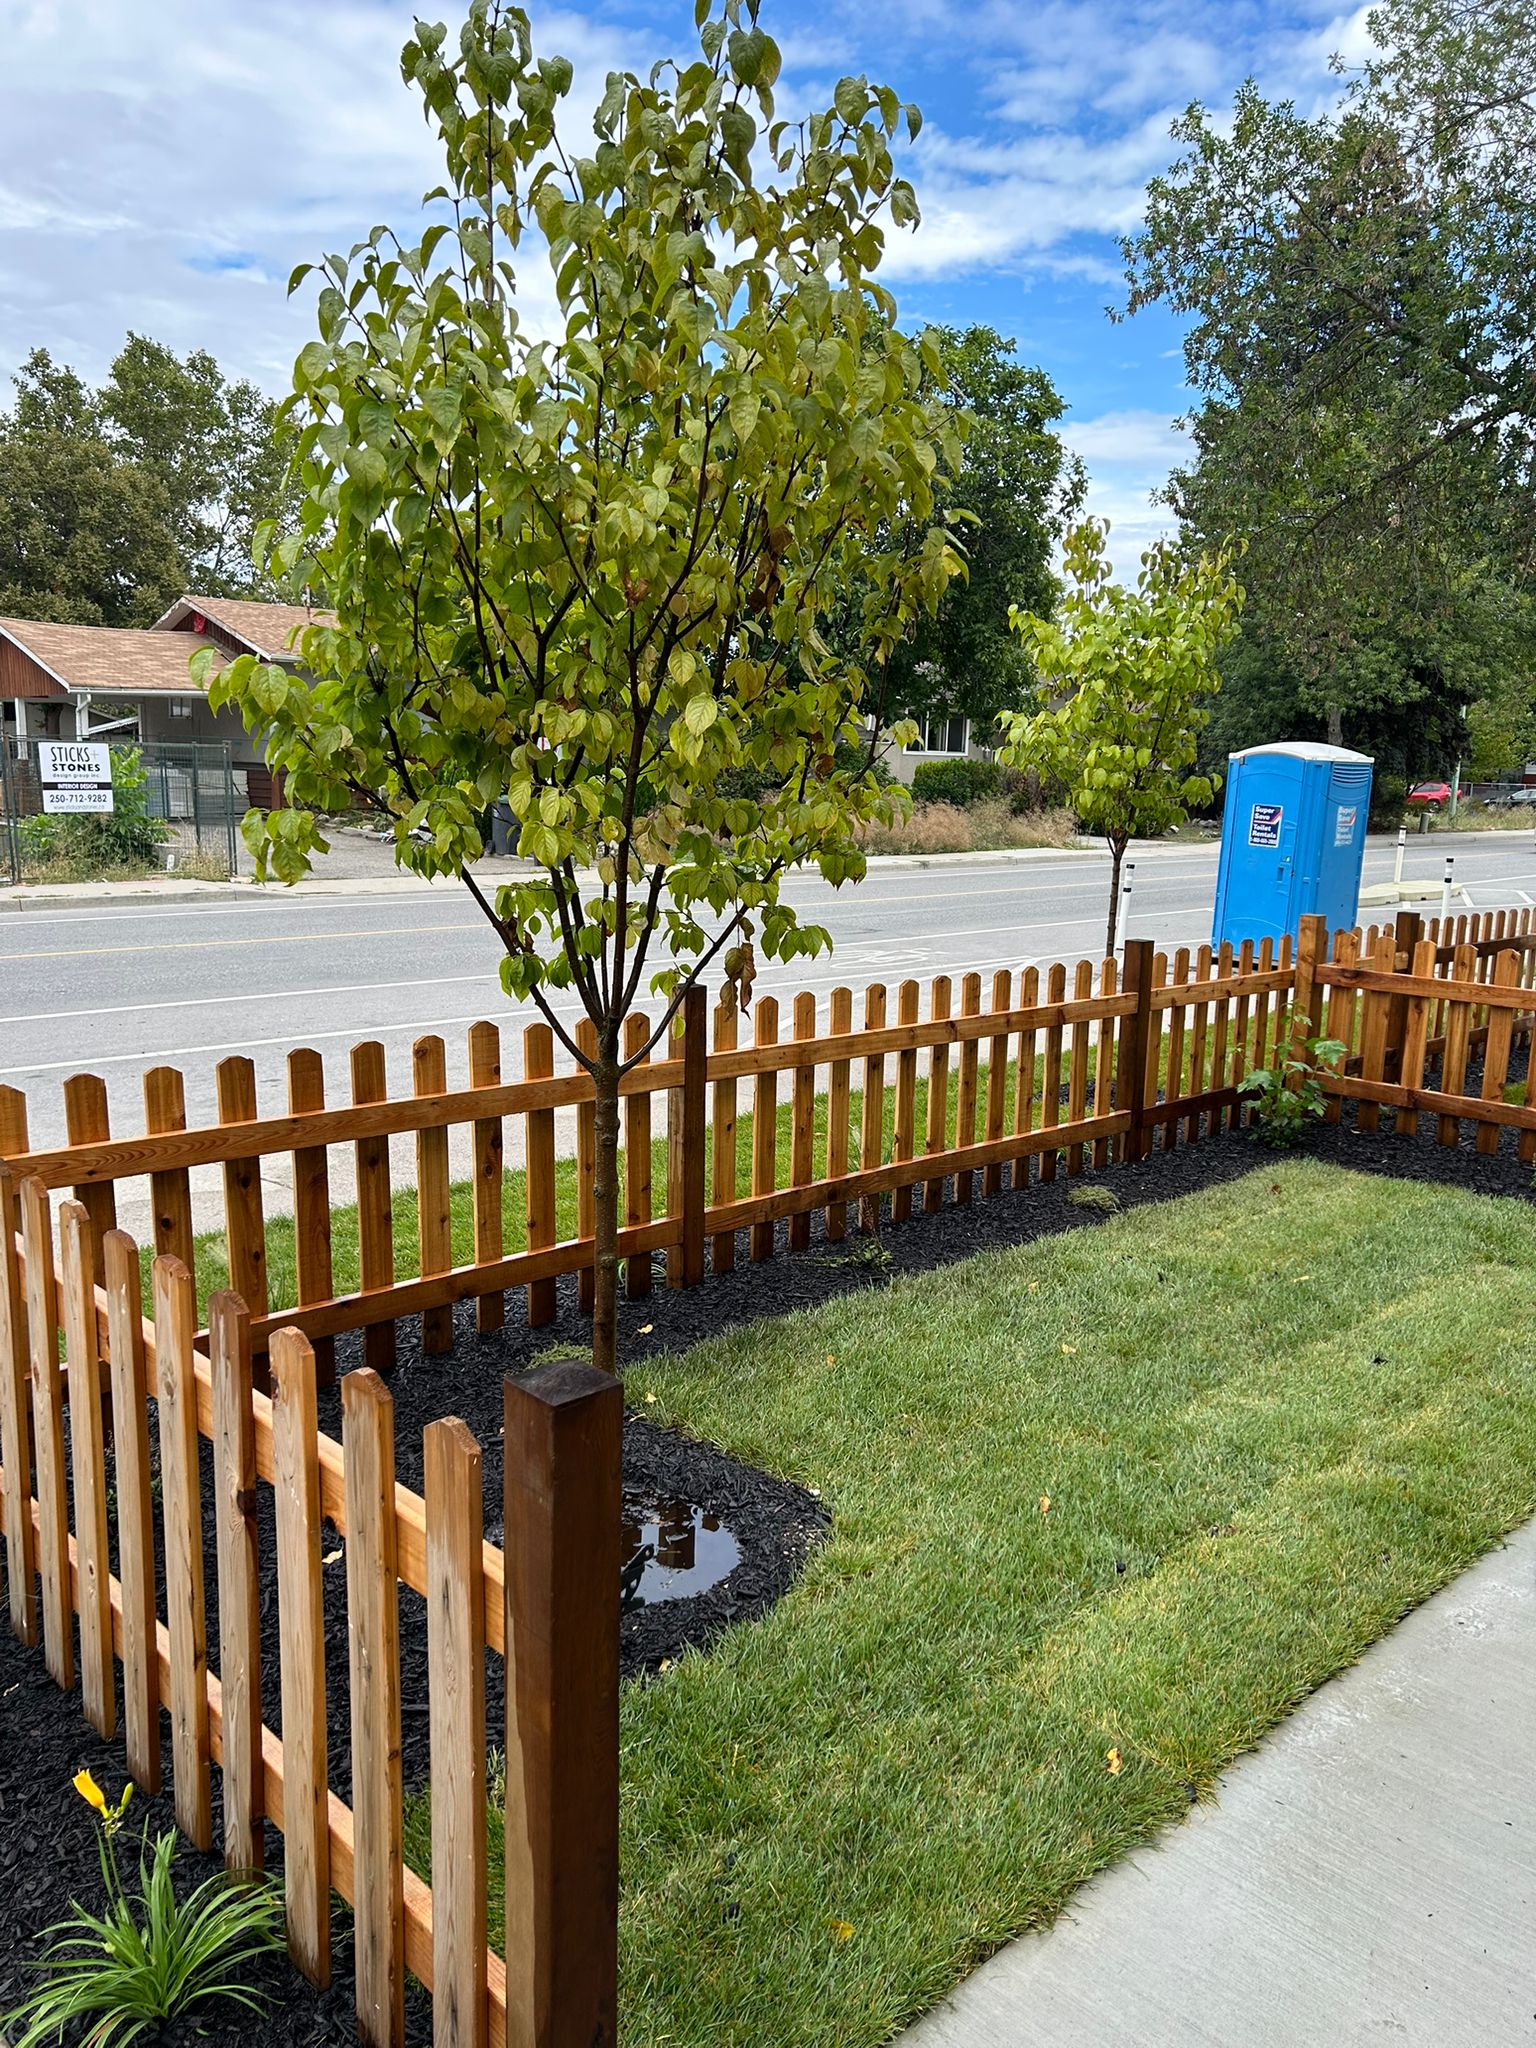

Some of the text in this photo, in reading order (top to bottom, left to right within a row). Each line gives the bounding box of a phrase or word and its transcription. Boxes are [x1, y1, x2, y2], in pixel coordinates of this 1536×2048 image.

[52, 763, 101, 772] STONES
[49, 794, 107, 803] 250-712-9282
[1255, 806, 1275, 814] Super
[1252, 830, 1276, 838] Rentals
